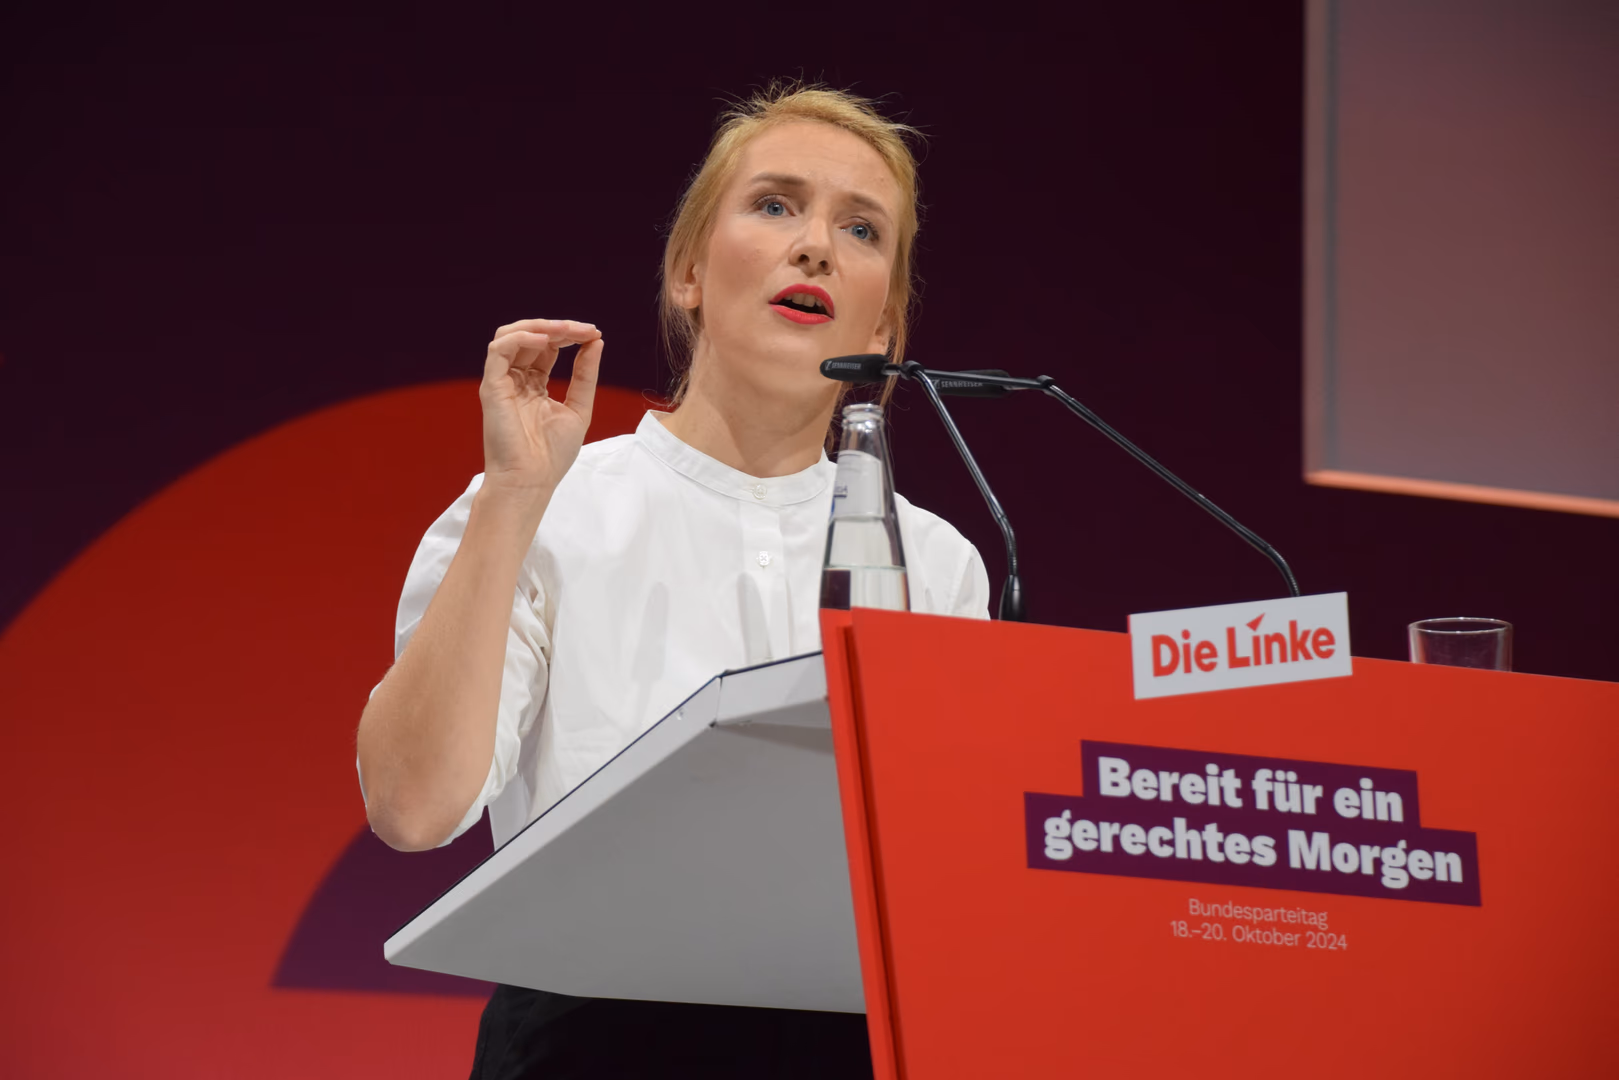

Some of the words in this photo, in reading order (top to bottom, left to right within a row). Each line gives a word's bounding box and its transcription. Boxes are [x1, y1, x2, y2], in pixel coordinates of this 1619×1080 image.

[1151, 629, 1218, 677] Die
[1227, 613, 1336, 669] Linke
[1097, 756, 1242, 807] Bereit
[1252, 770, 1323, 815] für
[1334, 778, 1404, 822] ein
[1043, 809, 1276, 866] gerechtes
[1288, 829, 1464, 889] Morgen
[1188, 898, 1328, 930] Bundesparteitag
[1233, 926, 1299, 946] Oktober
[1305, 931, 1347, 950] 2024
